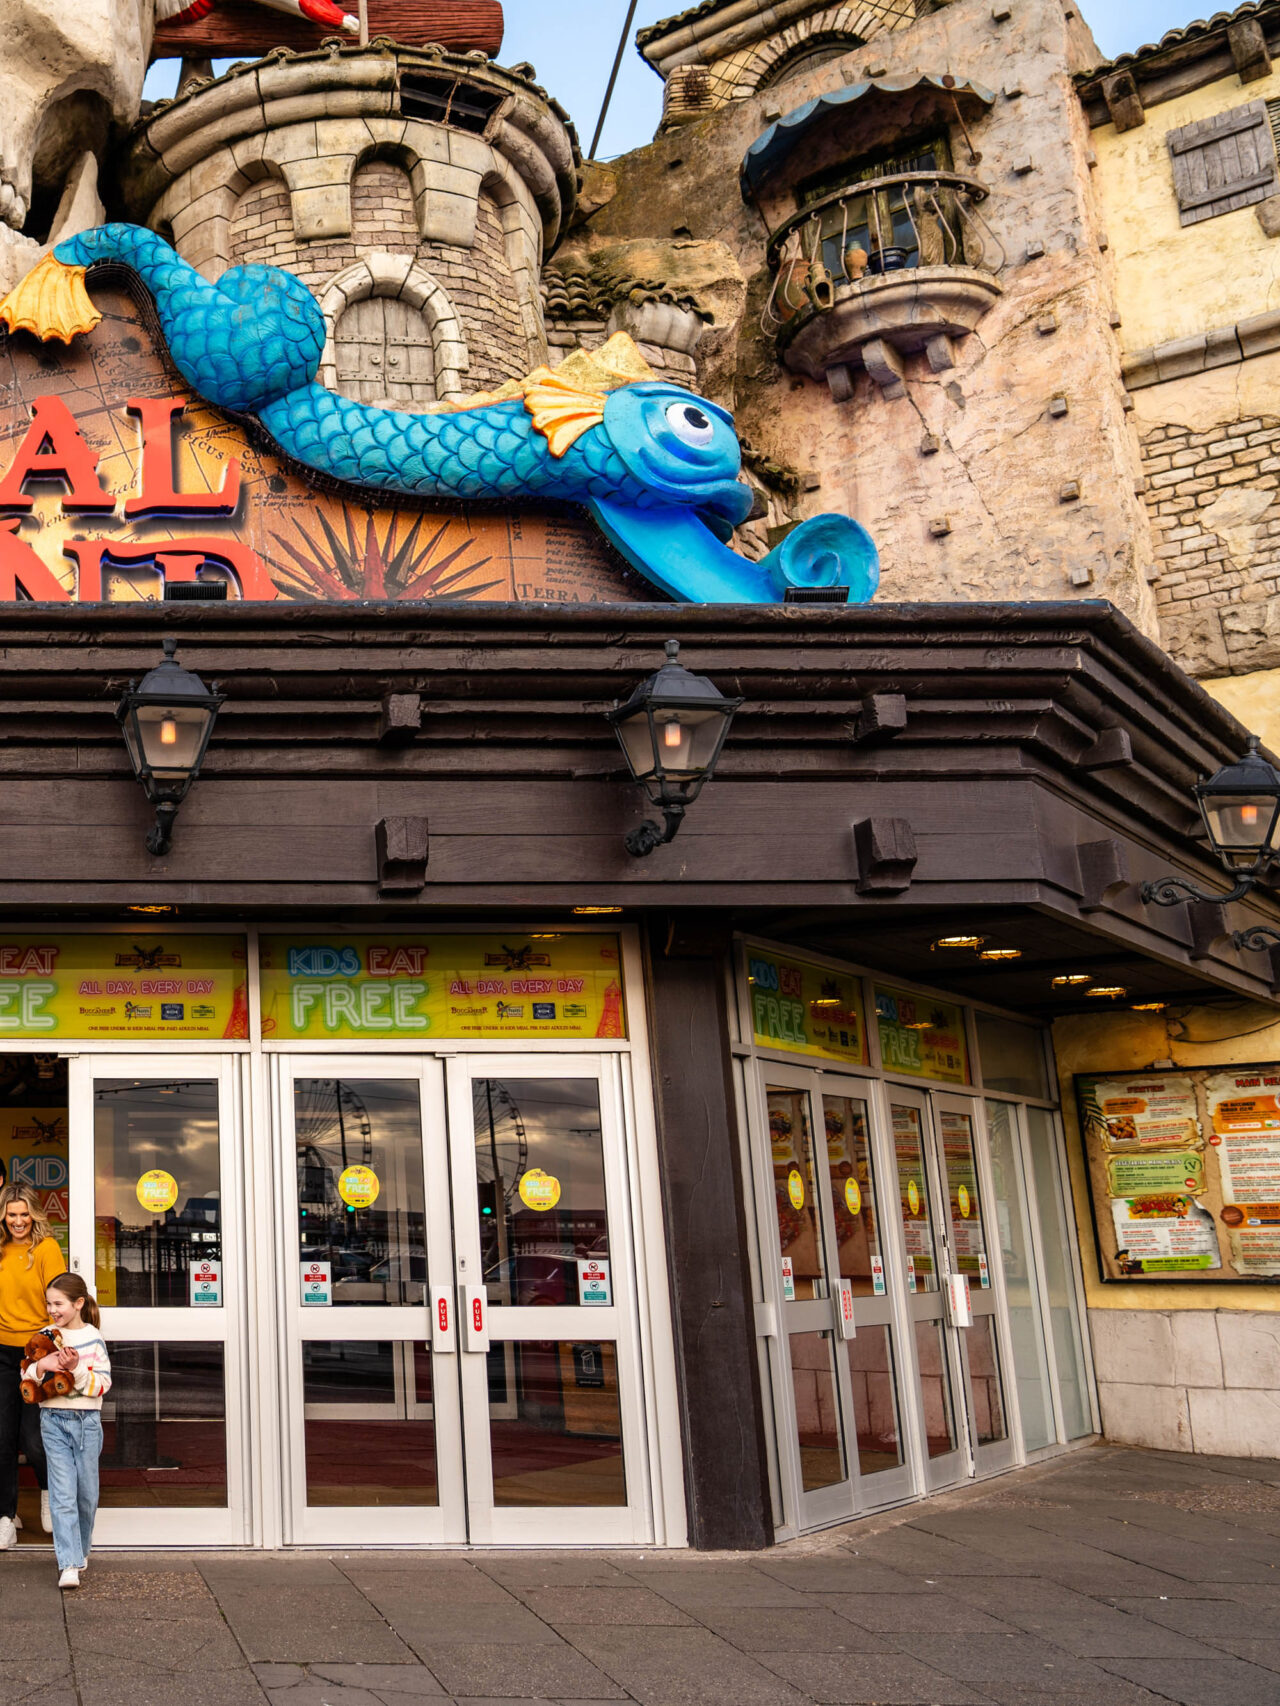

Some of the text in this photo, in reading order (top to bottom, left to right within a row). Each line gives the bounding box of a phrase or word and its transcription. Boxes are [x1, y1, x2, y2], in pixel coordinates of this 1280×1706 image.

[0, 947, 57, 974] EAT
[289, 948, 428, 975] KIDS EAT
[79, 981, 214, 996] ALL DAY, EVERY DAY
[450, 980, 584, 995] ALL DAY, EVERY DAY
[292, 983, 428, 1027] FREE
[754, 993, 808, 1044] FREE
[879, 1024, 922, 1067] FREE
[1235, 1077, 1261, 1088] MAIN
[12, 1157, 69, 1187] KID
